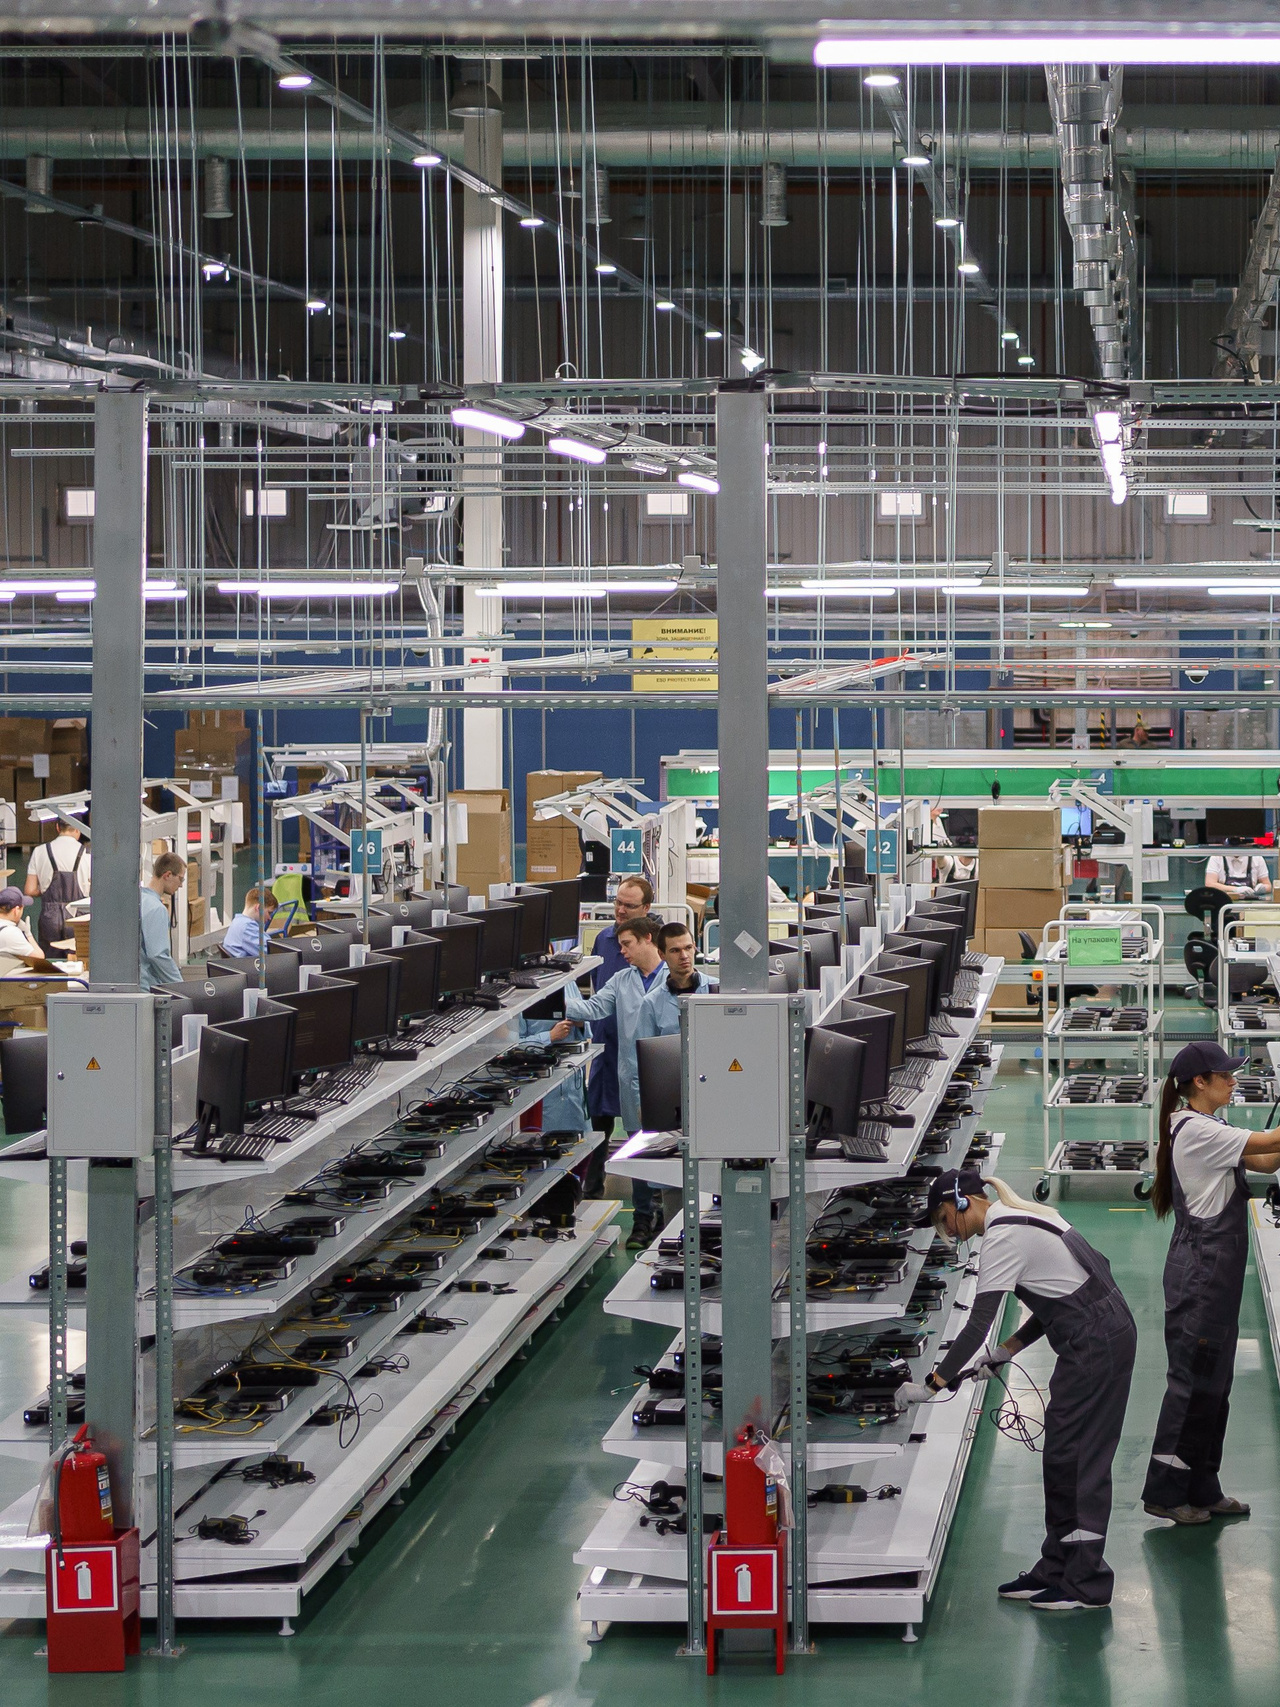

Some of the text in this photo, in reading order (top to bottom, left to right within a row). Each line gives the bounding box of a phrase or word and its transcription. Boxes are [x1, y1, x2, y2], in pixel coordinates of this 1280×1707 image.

[1098, 772, 1106, 784] 4
[617, 840, 636, 854] 44
[1072, 936, 1118, 945] На упаковку
